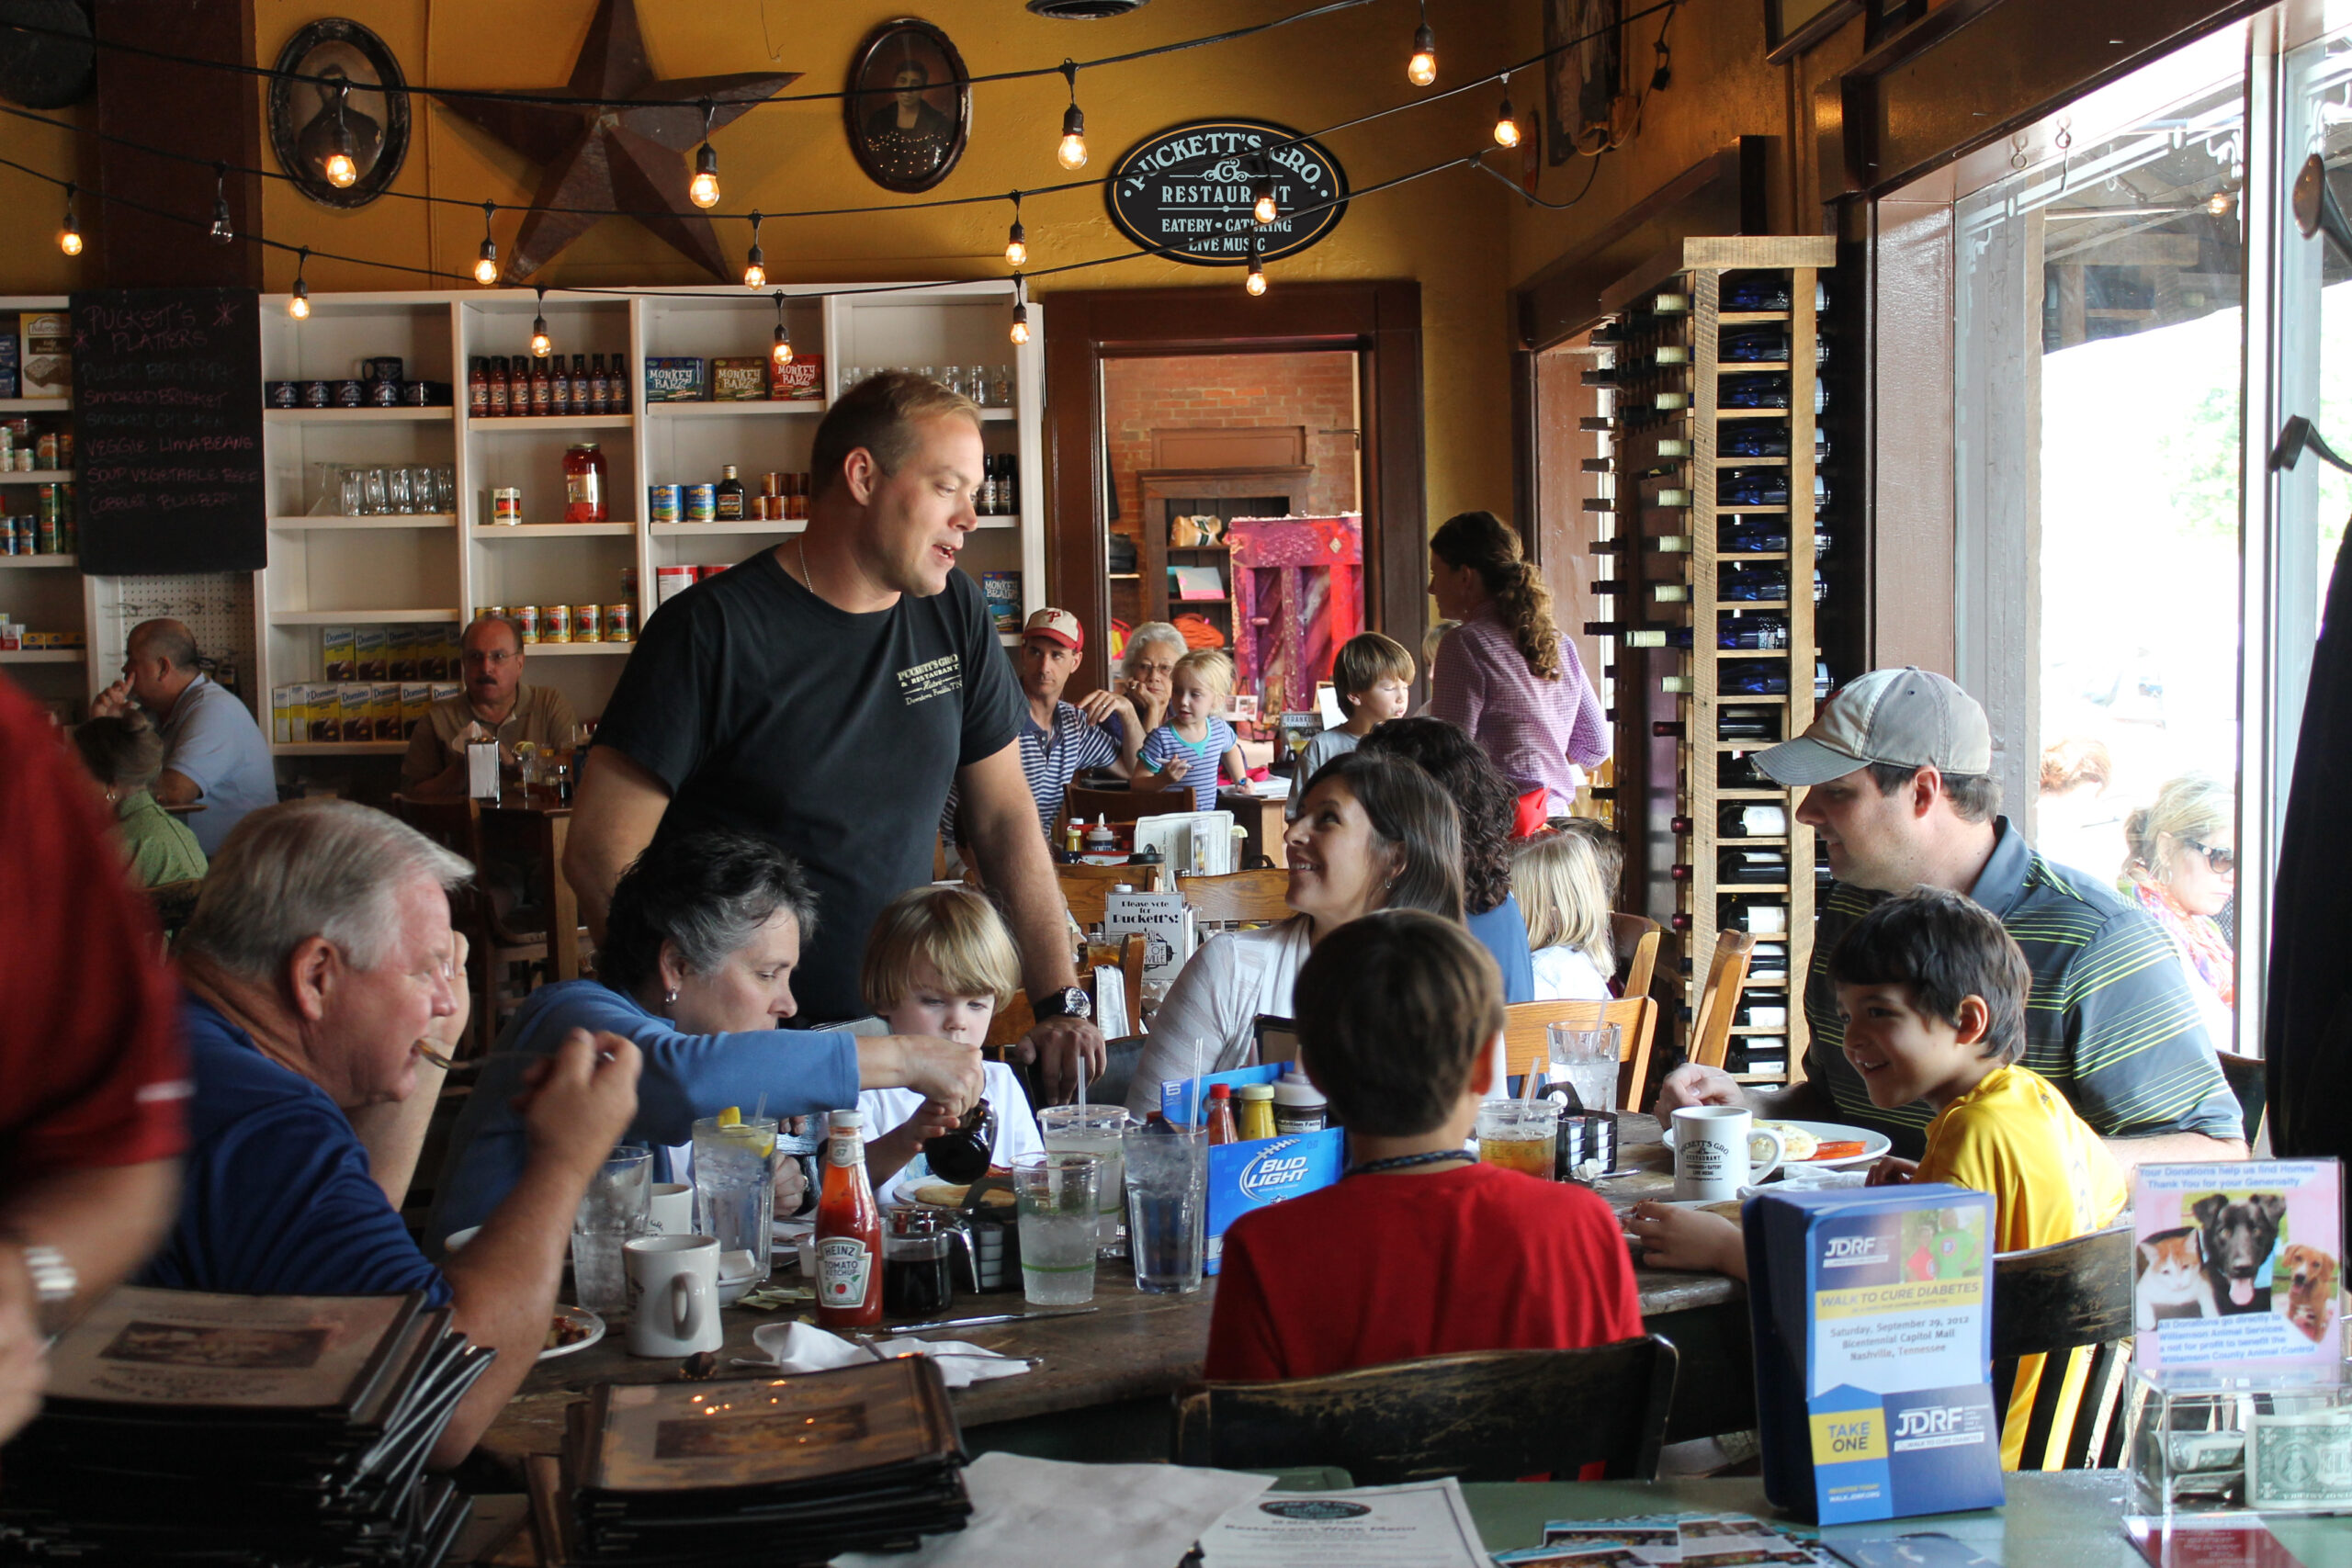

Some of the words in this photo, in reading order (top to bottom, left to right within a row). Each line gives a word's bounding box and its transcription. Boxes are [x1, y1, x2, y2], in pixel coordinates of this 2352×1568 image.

[1125, 132, 1262, 191] PUCKETT'S
[1161, 186, 1291, 203] RESTAURT
[1161, 219, 1213, 232] EATERY
[1188, 237, 1220, 252] LIVE
[1223, 237, 1265, 252] MUSC
[82, 301, 196, 335] PUCKETT'S
[111, 330, 208, 355] PLATTERS
[650, 369, 693, 384] MONKEY
[718, 368, 761, 383] MONKEY
[778, 365, 816, 379] MONKEY
[84, 389, 156, 406] SMOKED
[85, 437, 148, 457] VEGGIE
[86, 467, 127, 484] SOUP
[130, 468, 218, 484] VEGETABLE
[1046, 611, 1061, 623] P
[326, 631, 352, 644] Domino
[311, 689, 337, 700] Domino
[343, 691, 368, 702] Domino
[403, 687, 430, 698] Domino
[1114, 914, 1179, 924] Puckett's!
[1259, 1156, 1307, 1174] BUD
[2140, 1168, 2161, 1178] Your
[2165, 1167, 2215, 1176] Donations
[1248, 1168, 1309, 1189] LIGHT
[2148, 1179, 2178, 1189] Thank
[2181, 1179, 2199, 1189] You
[2245, 1178, 2300, 1188] Generosity
[825, 1245, 855, 1257] HEINZ
[1824, 1236, 1876, 1257] JDRF
[824, 1260, 858, 1269] TOMATO
[1821, 1294, 1858, 1308] WALK
[1860, 1292, 1878, 1303] TO
[1882, 1287, 1914, 1302] CURE
[1917, 1282, 1979, 1297] DIABETES
[1877, 1319, 1926, 1333] September
[1947, 1316, 1969, 1325] 2012
[2173, 1319, 2219, 1328] Donations
[1842, 1337, 1897, 1349] Bicentennial
[1900, 1332, 1932, 1344] Capitol
[1935, 1329, 1955, 1338] Mall
[1850, 1348, 1894, 1361] Nashville,
[1898, 1344, 1946, 1356] Tennessee
[2212, 1351, 2245, 1361] County
[2281, 1345, 2314, 1354] Control
[1894, 1406, 1962, 1437] JDRF
[1827, 1421, 1871, 1439] TAKE
[1832, 1436, 1868, 1452] ONE
